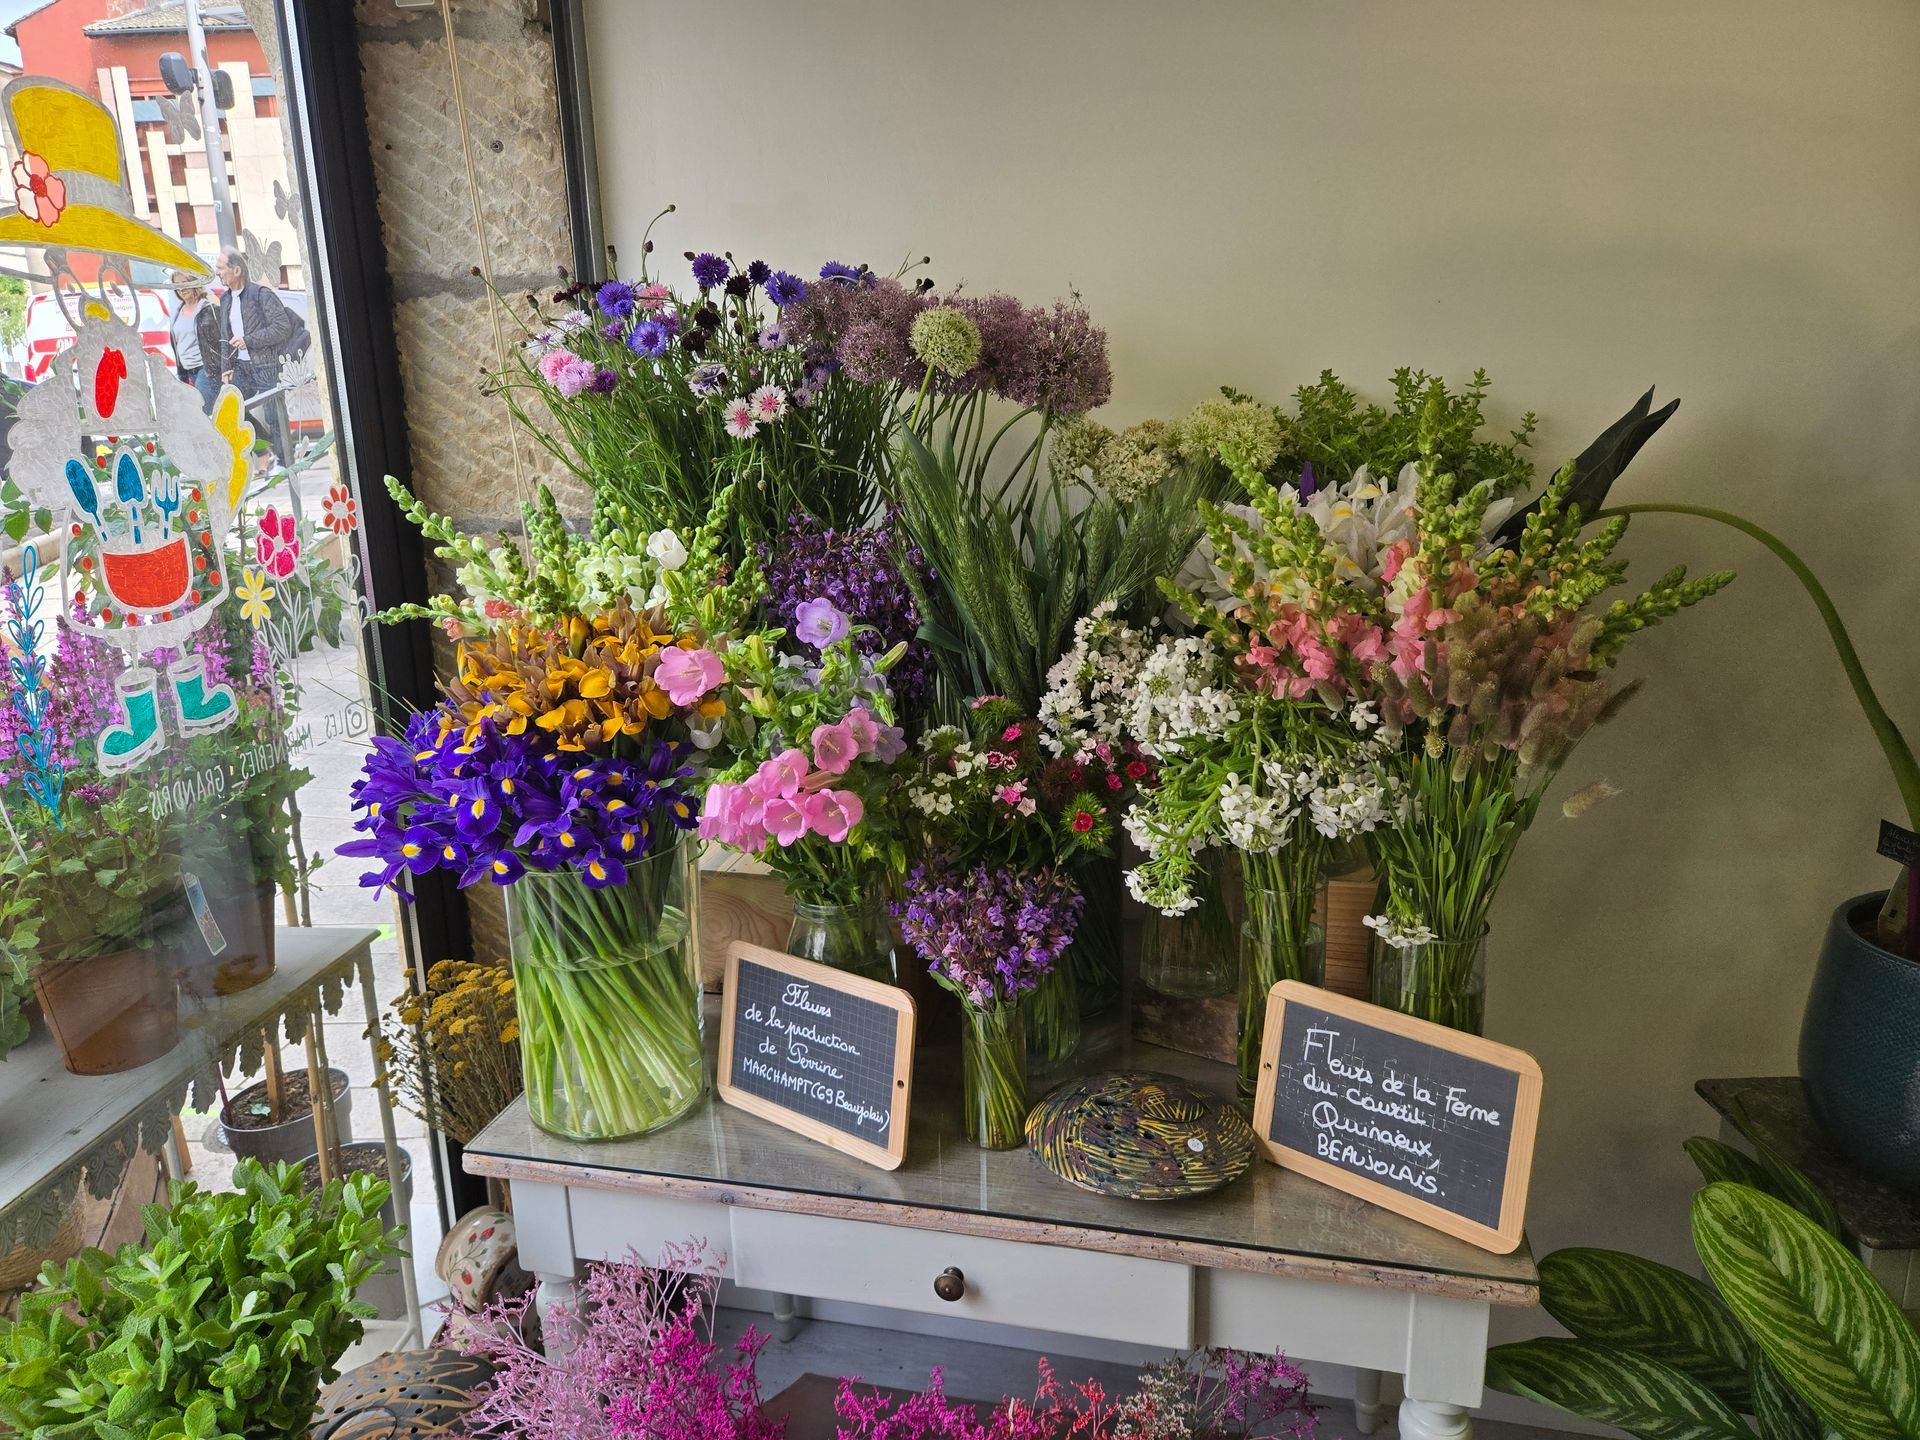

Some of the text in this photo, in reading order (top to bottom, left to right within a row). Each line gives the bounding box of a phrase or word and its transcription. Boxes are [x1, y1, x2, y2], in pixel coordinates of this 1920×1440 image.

[782, 983, 832, 1018] Fleurs
[744, 1003, 861, 1056] de la production
[758, 1037, 844, 1079] de Perrine
[1303, 1028, 1501, 1126] Fleurs de la Ferme
[743, 1057, 813, 1095] MARCHAMPT
[835, 1090, 891, 1133] Beaujolais)
[1303, 1067, 1339, 1097] du
